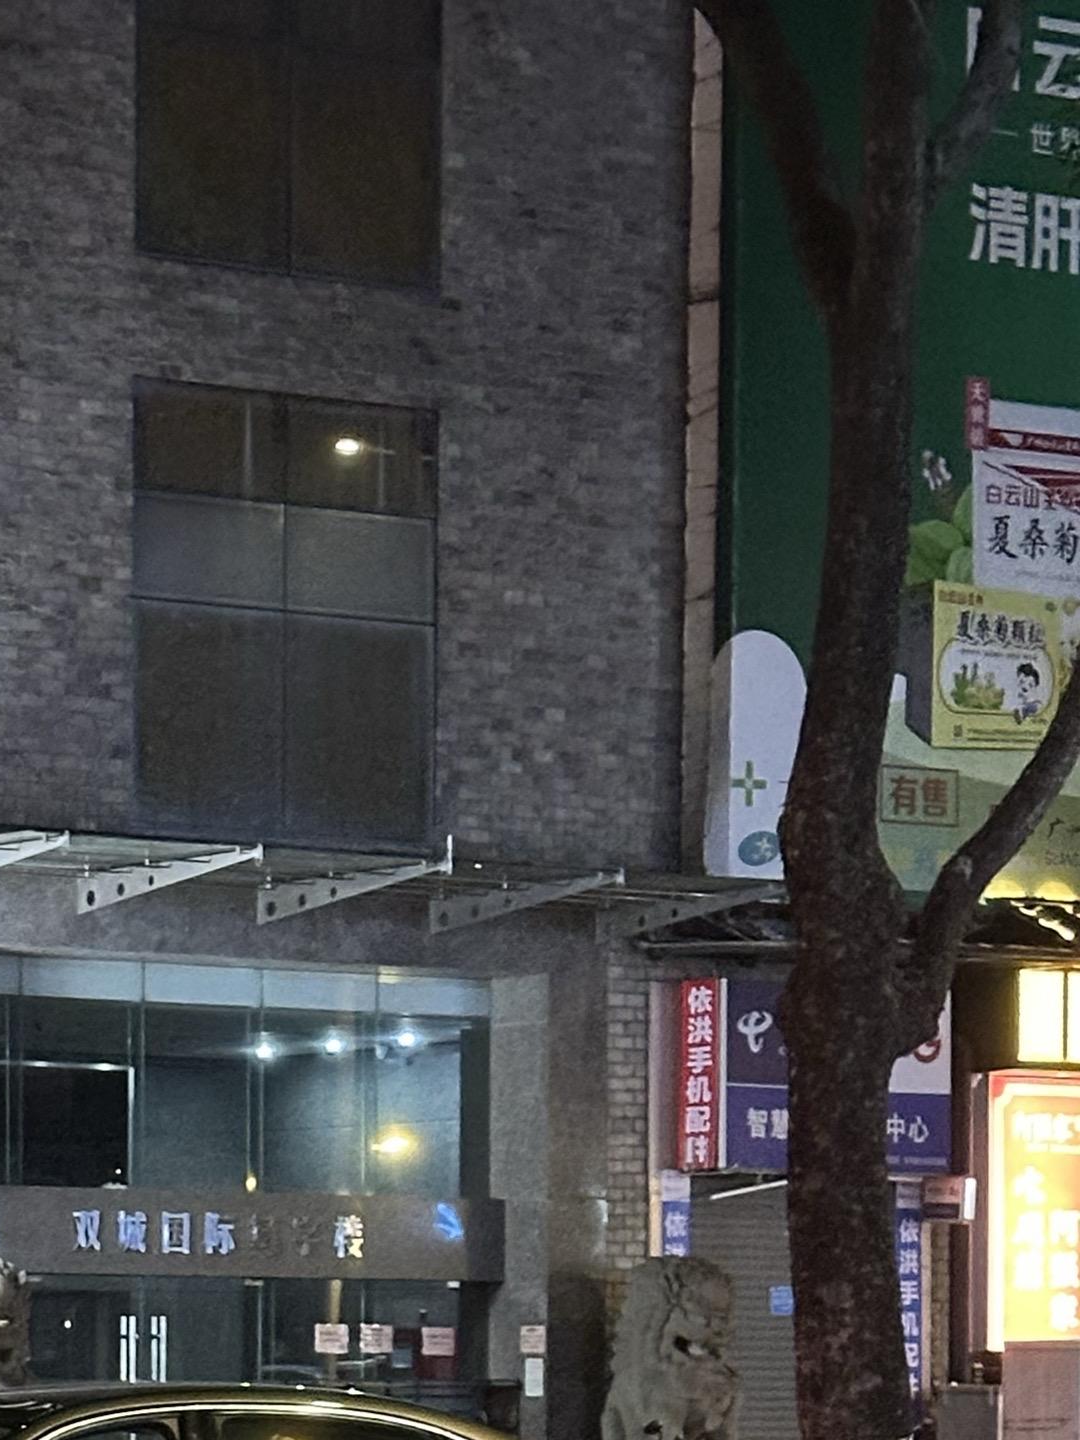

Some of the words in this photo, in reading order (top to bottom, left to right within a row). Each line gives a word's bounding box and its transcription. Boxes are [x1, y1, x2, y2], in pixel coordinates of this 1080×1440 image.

[988, 514, 1079, 565] 夏桑菊
[889, 775, 948, 817] 有售
[686, 985, 714, 1165] 依洪手机配件
[886, 1112, 929, 1144] 中心
